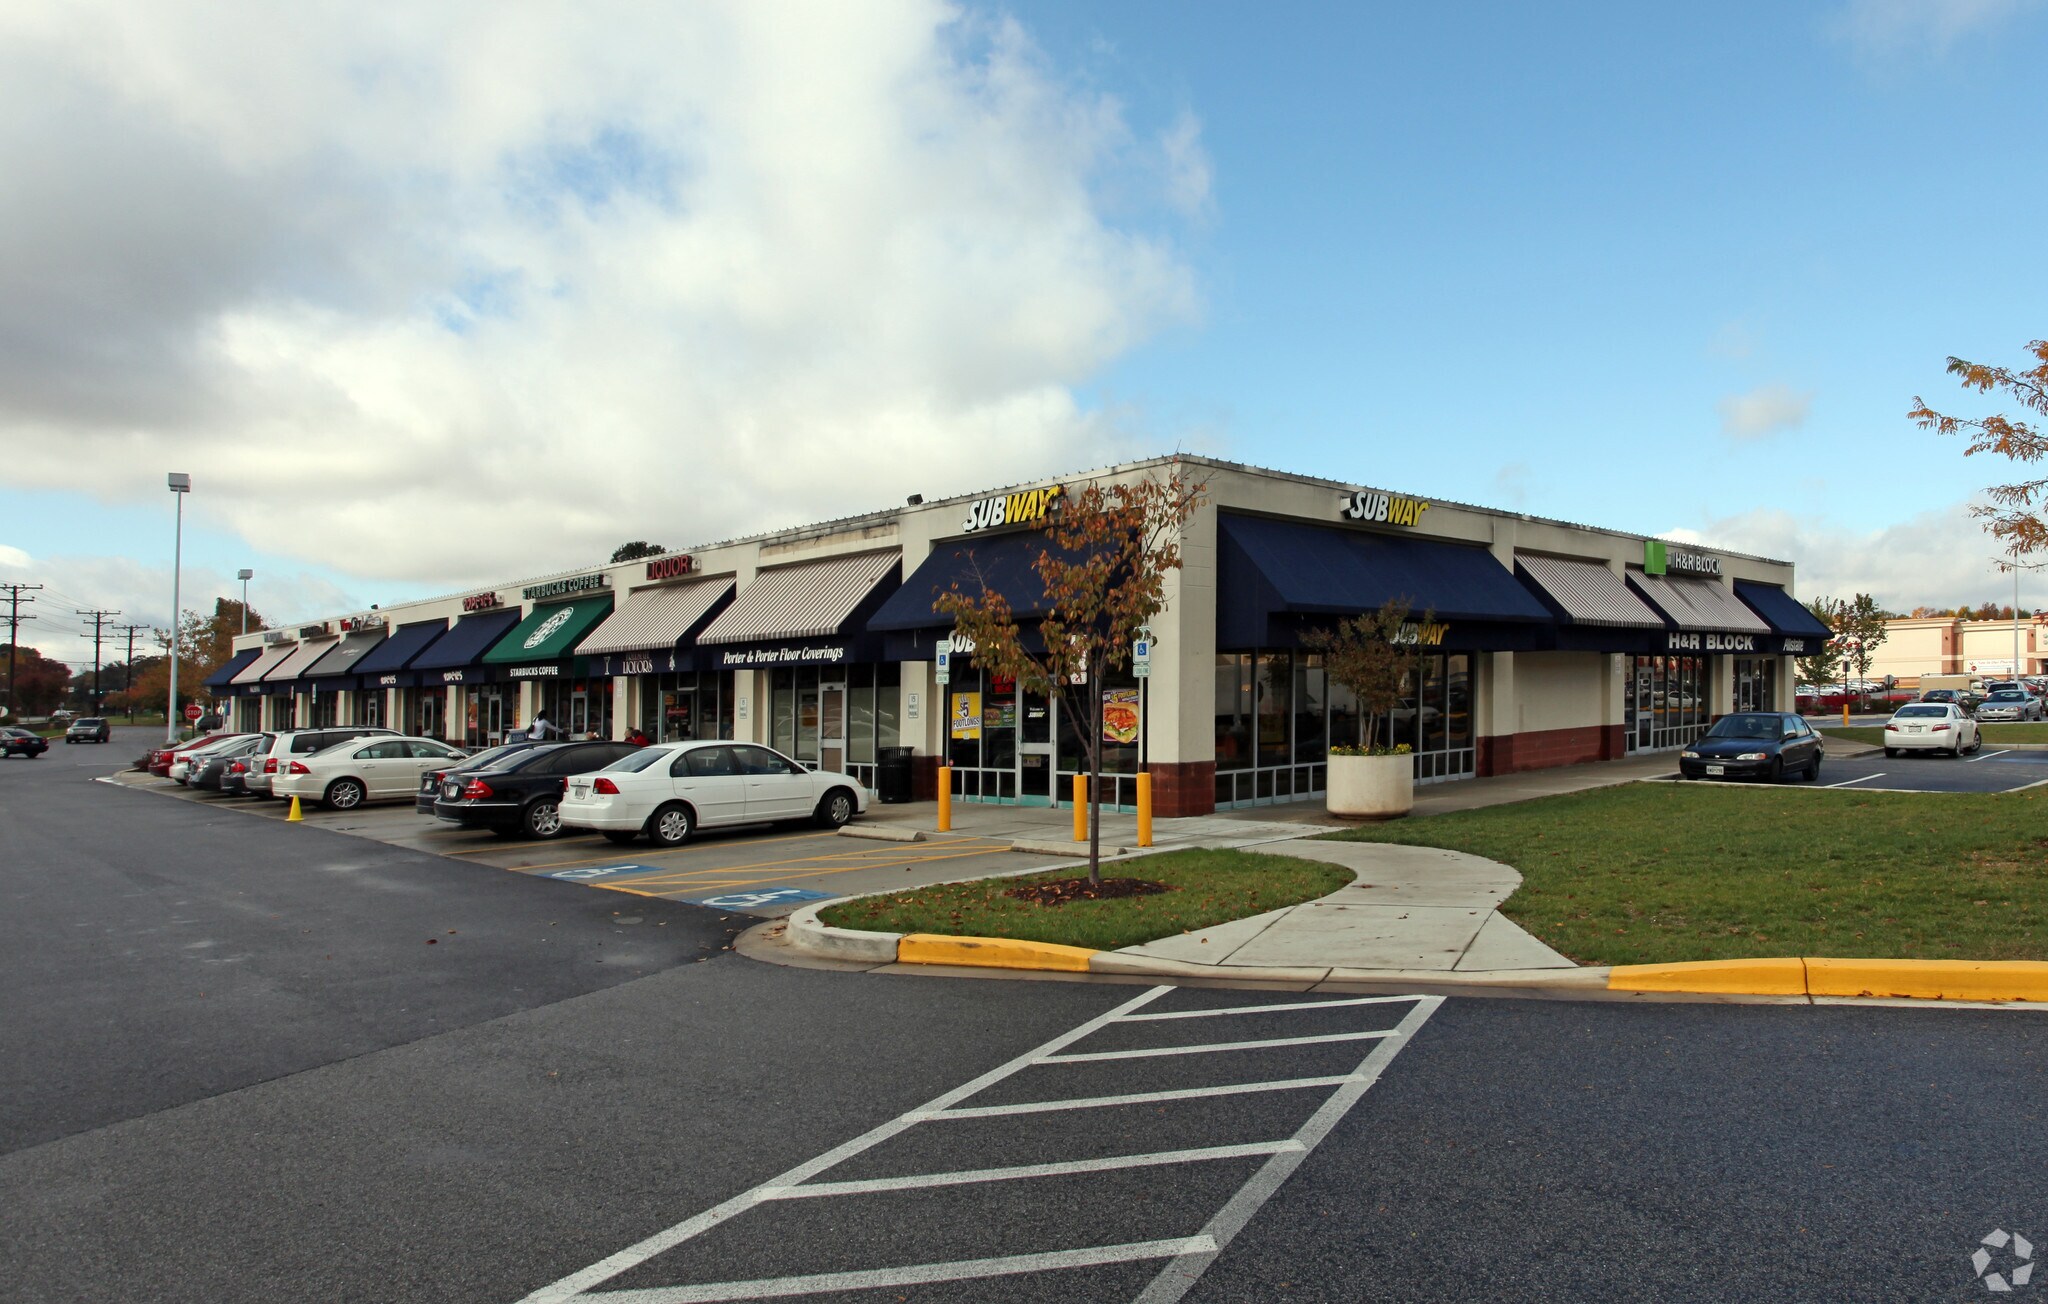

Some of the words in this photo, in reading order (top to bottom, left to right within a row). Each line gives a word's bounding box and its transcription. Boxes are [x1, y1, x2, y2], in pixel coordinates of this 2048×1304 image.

[961, 485, 1060, 531] SUBWAY
[1350, 491, 1430, 526] SUBWAY
[647, 555, 689, 580] LIQUOR
[1675, 552, 1694, 570] H&R
[1696, 556, 1723, 574] BLOCK
[523, 580, 566, 599] STARBUCKS
[568, 575, 600, 591] COFFEE
[1668, 632, 1700, 650] H&R
[1706, 635, 1754, 650] BLOCK
[723, 652, 746, 664] Porter
[747, 650, 754, 663] &
[755, 649, 779, 662] Porter
[779, 648, 801, 661] Floor
[801, 645, 844, 662] Coverings
[510, 667, 538, 676] STARBUCKS
[539, 666, 558, 675] COFFEE
[622, 660, 653, 675] LIQUORS
[953, 718, 980, 727] FOOTLONGS
